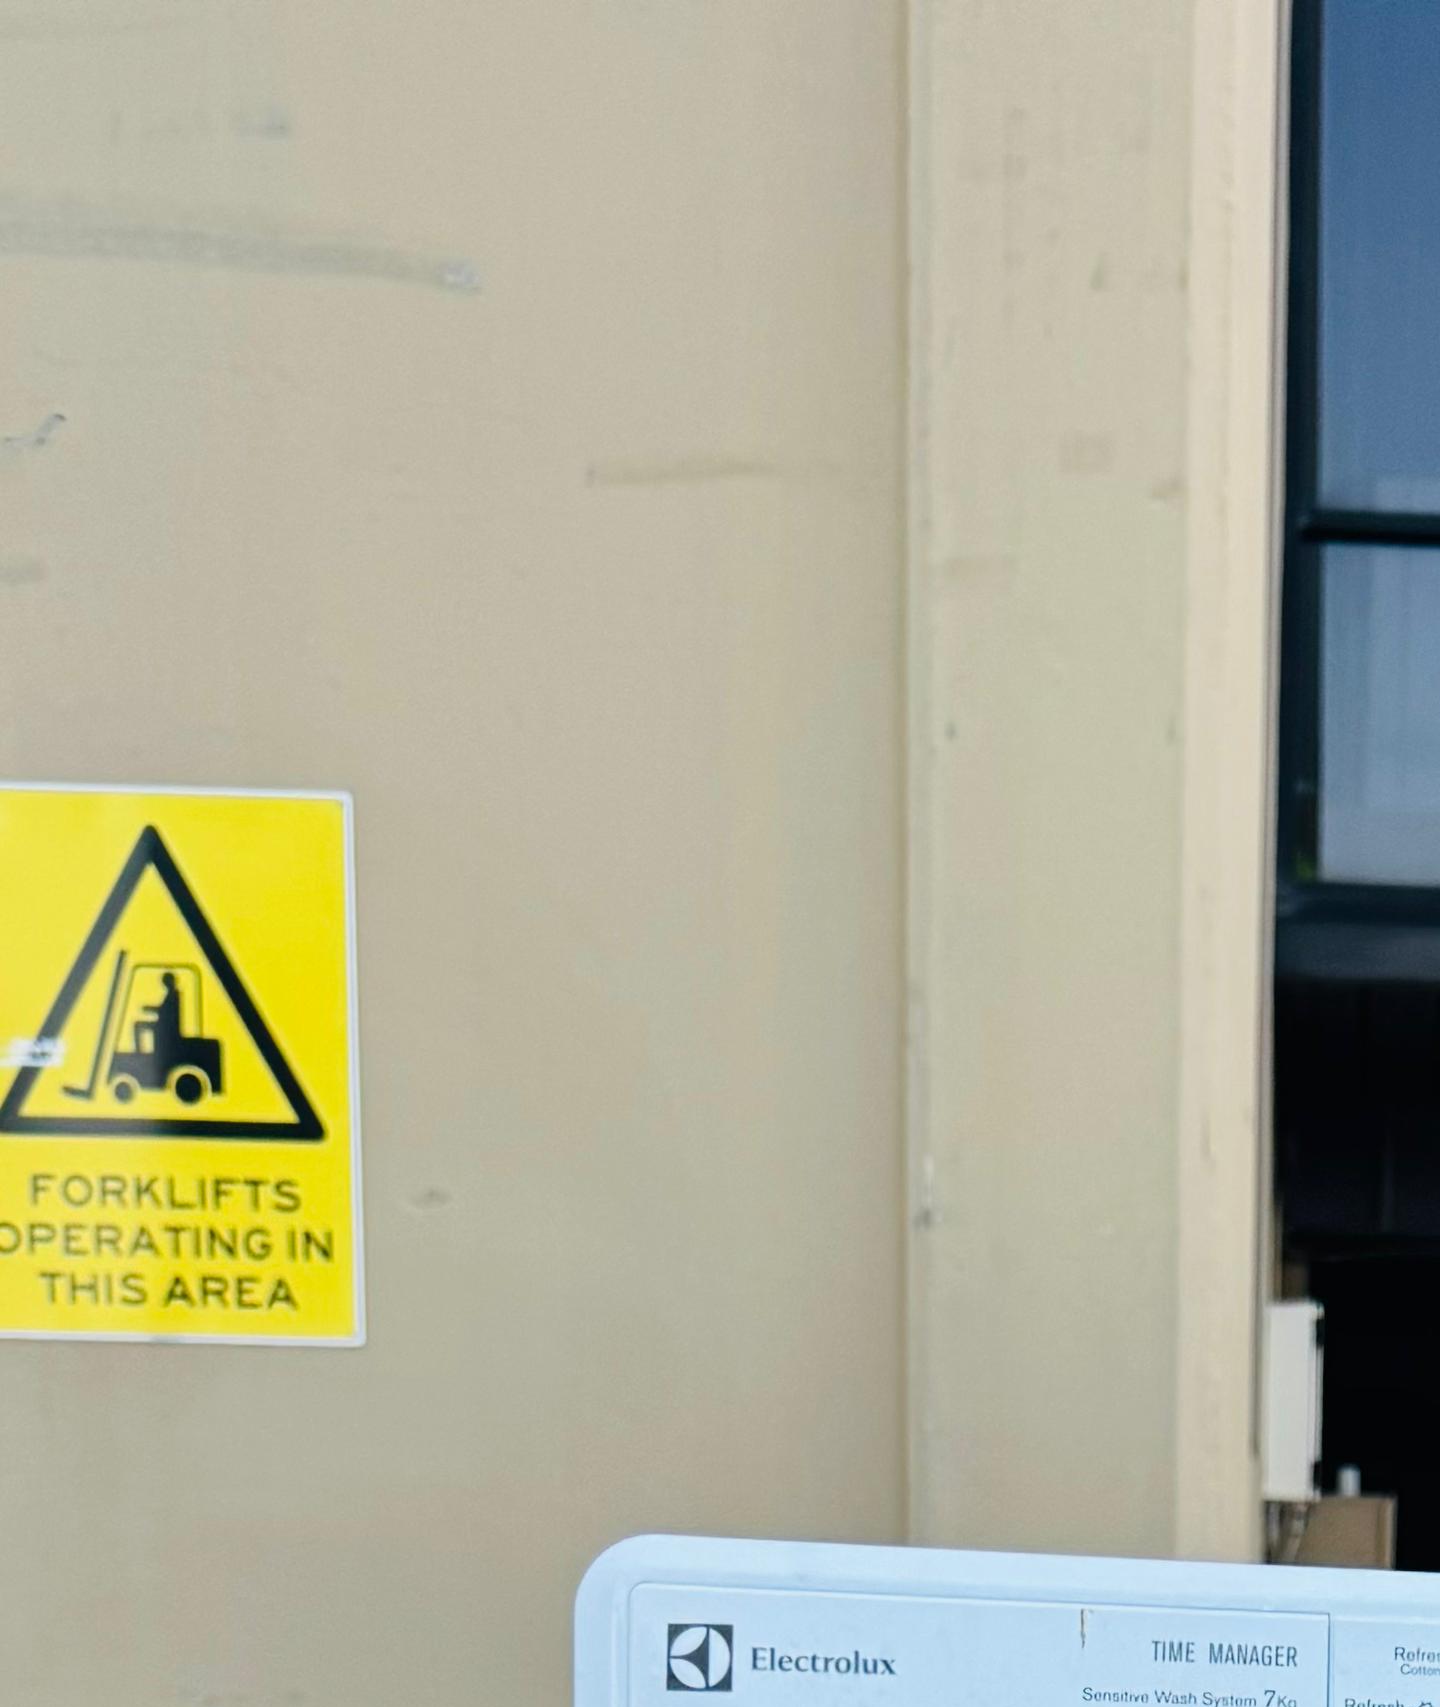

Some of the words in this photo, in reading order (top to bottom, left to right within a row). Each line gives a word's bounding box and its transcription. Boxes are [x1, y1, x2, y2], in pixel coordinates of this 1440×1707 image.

[29, 1173, 303, 1213] FORKLIFTS
[0, 1221, 274, 1261] OPERATING
[286, 1227, 335, 1264] IN
[39, 1271, 149, 1306] THIS
[161, 1274, 299, 1312] AREA
[750, 1645, 898, 1677] Electrolux
[1151, 1640, 1196, 1664] TIME
[1208, 1642, 1299, 1668] MANAGER
[1081, 1686, 1150, 1704] Sensitive
[1154, 1689, 1197, 1705] Wash
